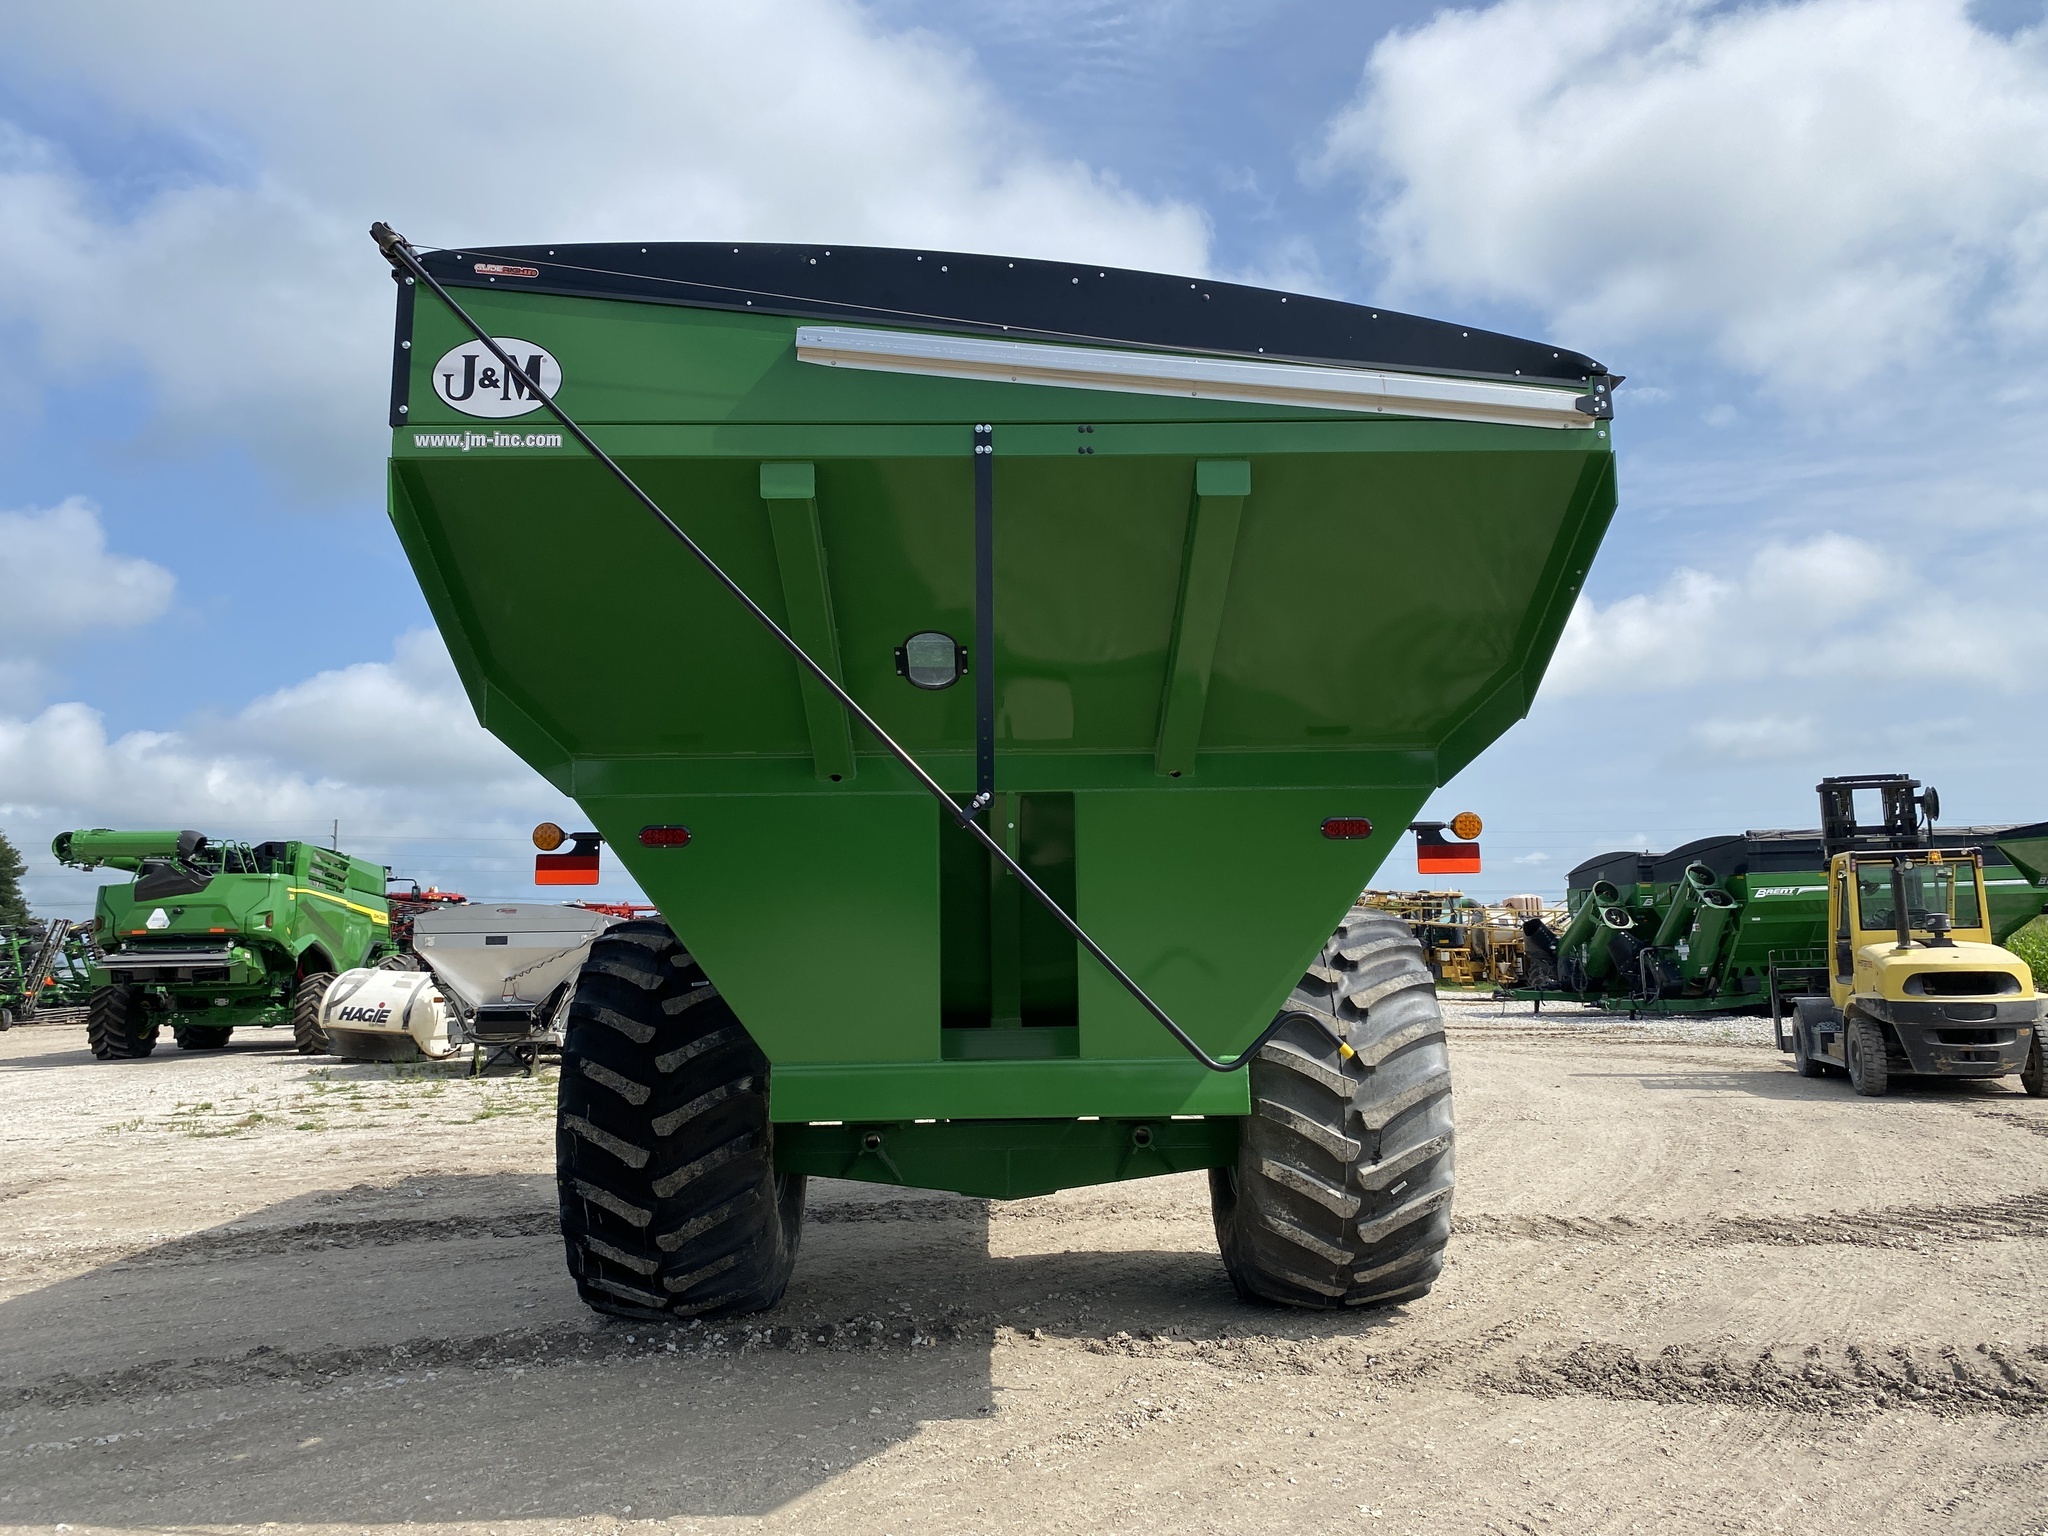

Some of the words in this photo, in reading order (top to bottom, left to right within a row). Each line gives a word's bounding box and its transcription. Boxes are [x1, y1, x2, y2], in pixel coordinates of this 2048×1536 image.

[442, 354, 544, 402] J&M
[414, 430, 562, 451] www.jm-inc.com
[1753, 887, 1796, 898] BRENT
[338, 1002, 392, 1024] HAGIE
